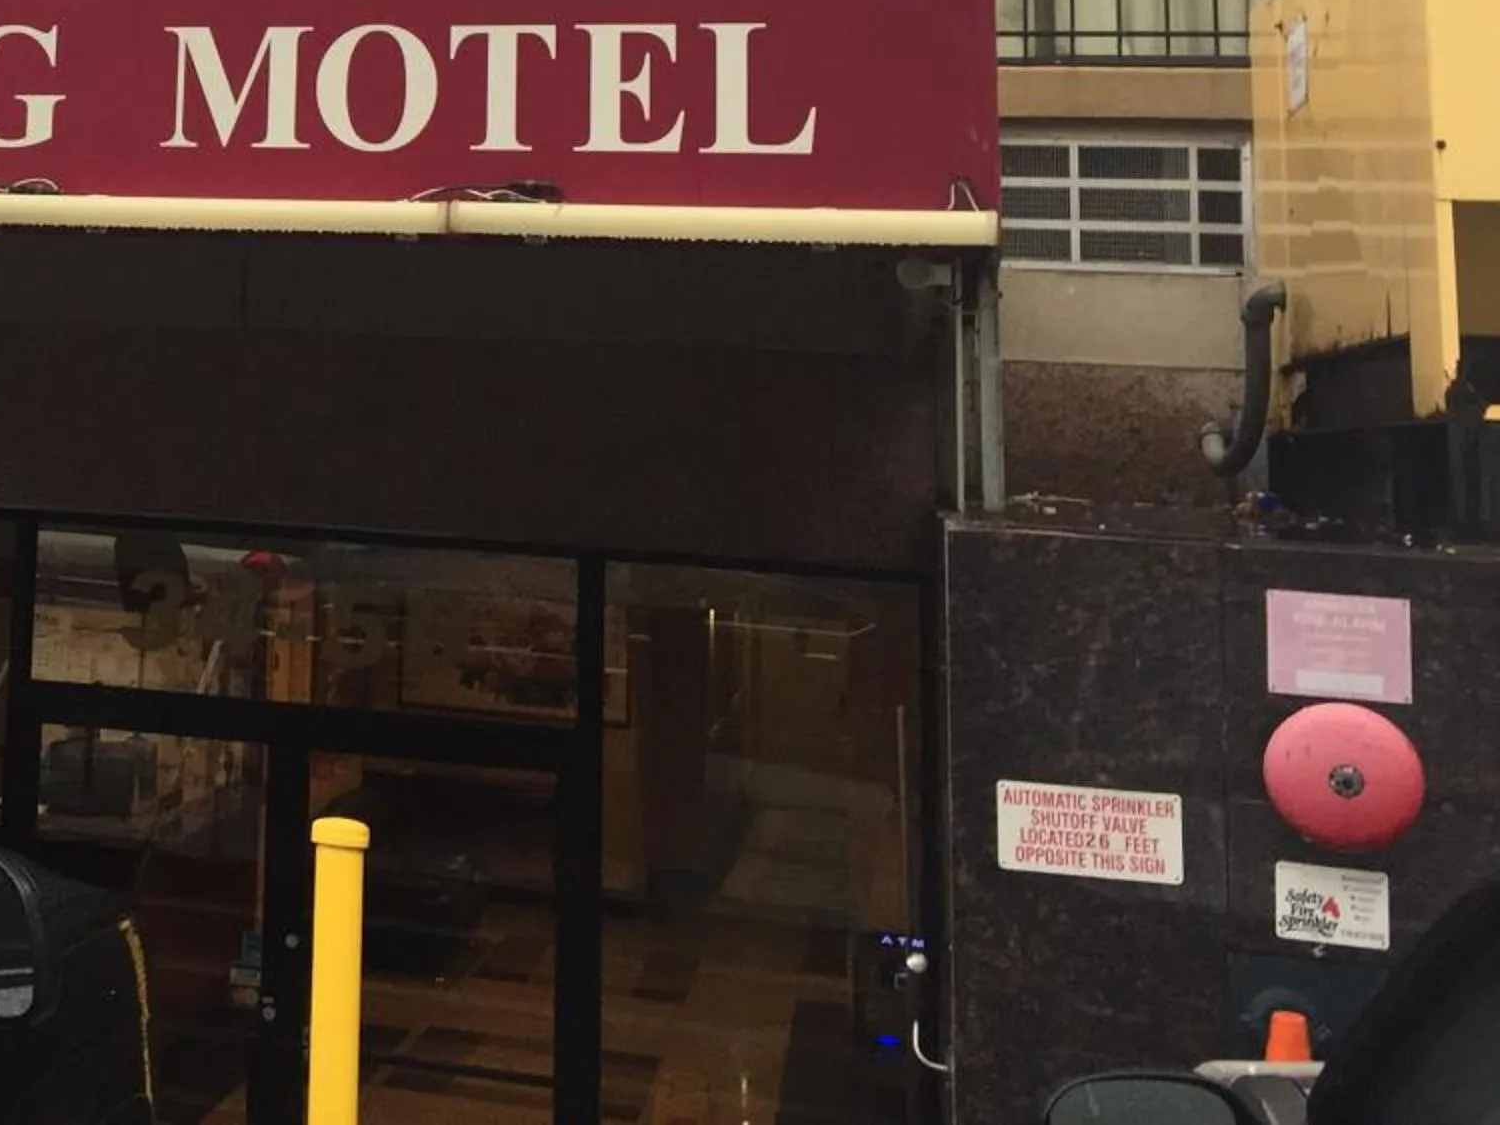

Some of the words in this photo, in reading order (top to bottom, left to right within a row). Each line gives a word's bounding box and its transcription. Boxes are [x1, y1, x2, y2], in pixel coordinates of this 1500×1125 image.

[160, 23, 817, 154] MOTEL
[1003, 788, 1088, 811] AUTOMATIC
[1091, 795, 1175, 819] SPRINKLER
[1031, 809, 1097, 830] SHUTOFF
[1102, 815, 1148, 835] VALVE
[1020, 827, 1083, 848] LOCATED
[1125, 837, 1160, 854] FEET
[1015, 845, 1088, 868] OPPOSITE
[1092, 853, 1125, 872] THIS
[1129, 857, 1166, 874] SIGN
[880, 935, 925, 948] ATM
